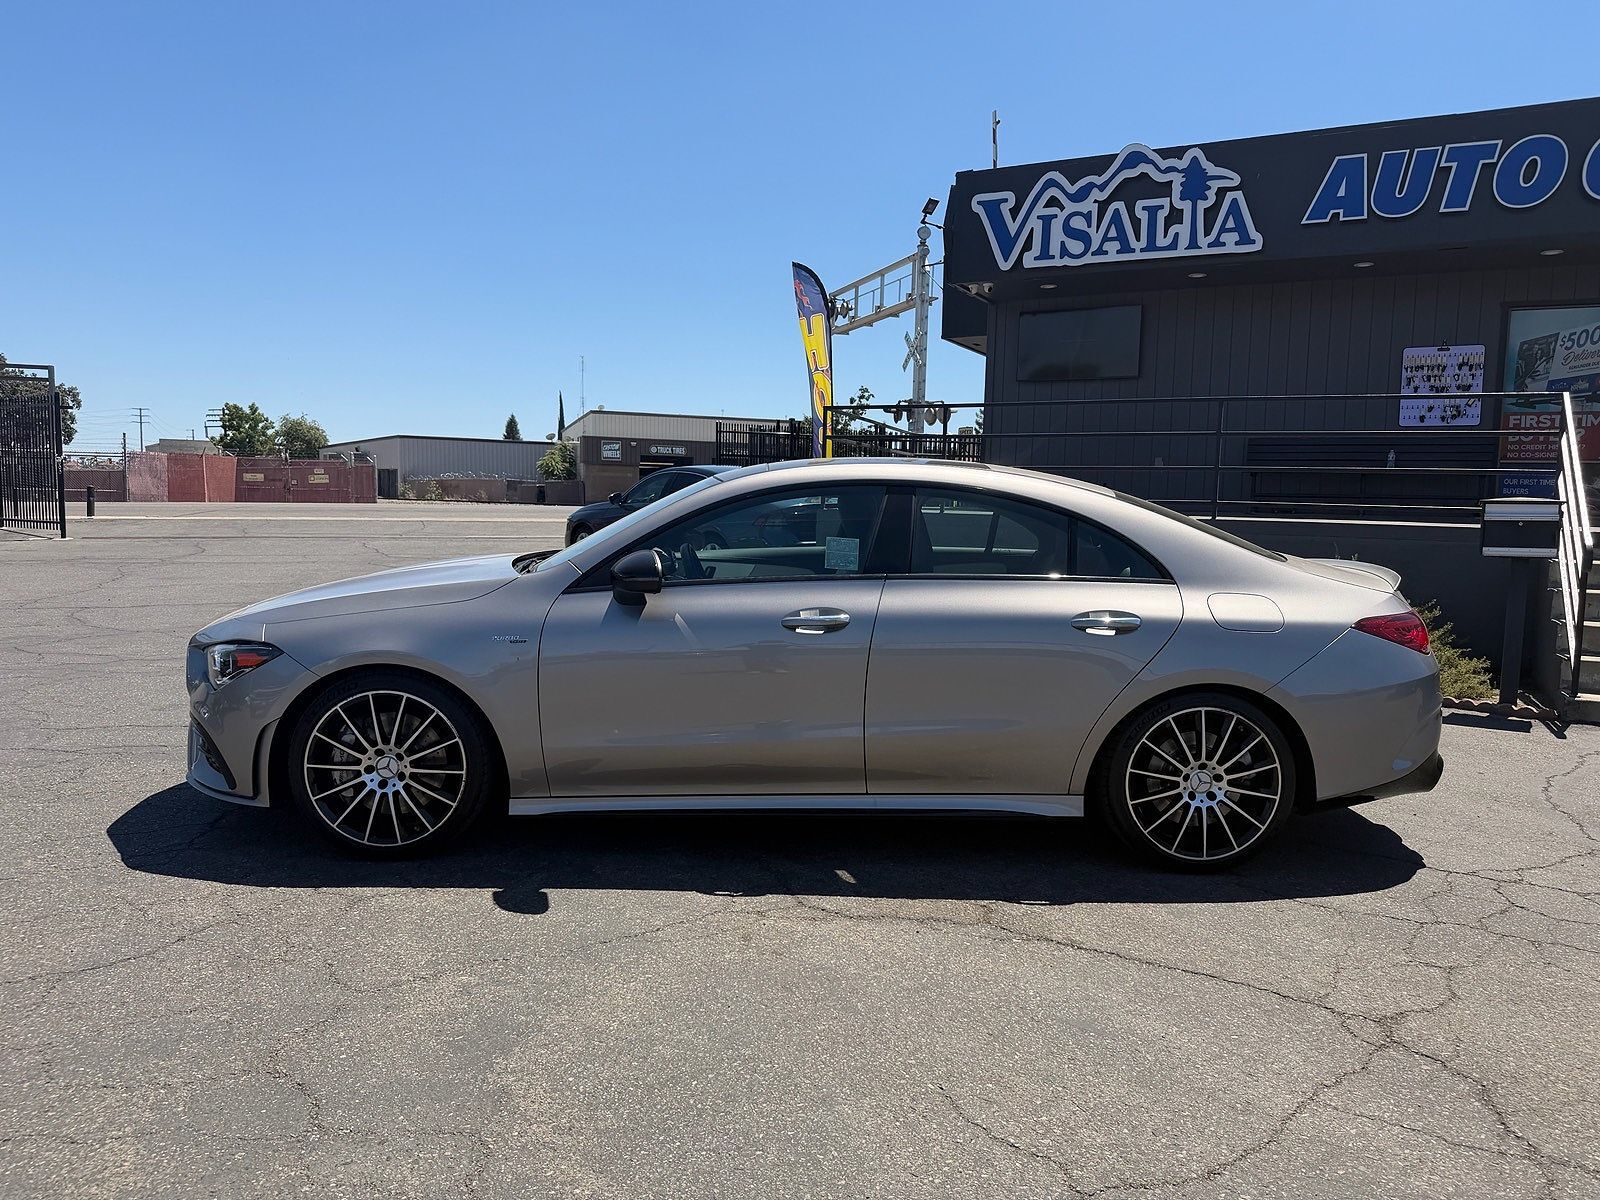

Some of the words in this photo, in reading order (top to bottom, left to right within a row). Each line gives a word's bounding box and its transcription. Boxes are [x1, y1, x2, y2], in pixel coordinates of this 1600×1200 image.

[1301, 134, 1569, 224] AUTO
[975, 158, 1259, 265] VISALIA
[1508, 414, 1561, 428] FIRST
[602, 450, 620, 458] WHEELS
[657, 446, 672, 454] TRUCK
[672, 447, 686, 455] TIRES
[1503, 478, 1518, 486] OUR
[1519, 478, 1539, 486] FIRST
[1502, 487, 1529, 495] BUYERS
